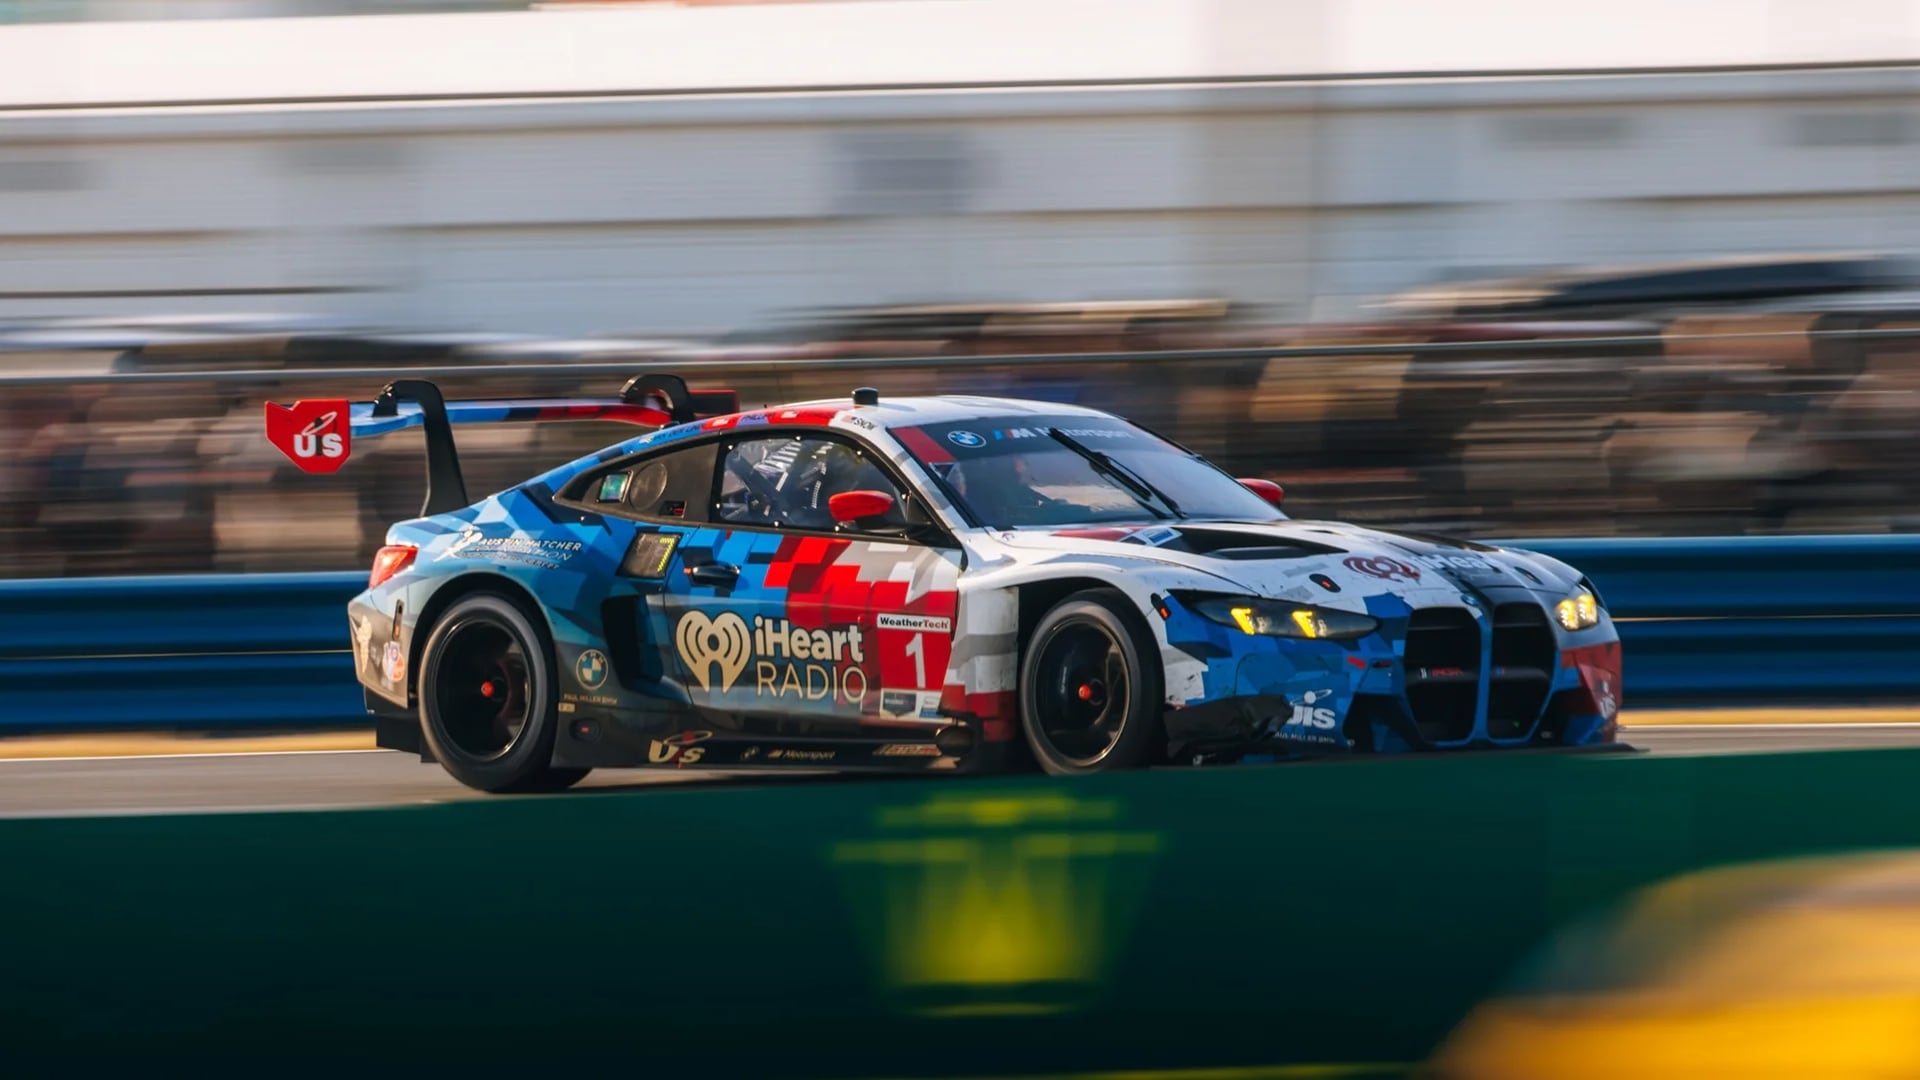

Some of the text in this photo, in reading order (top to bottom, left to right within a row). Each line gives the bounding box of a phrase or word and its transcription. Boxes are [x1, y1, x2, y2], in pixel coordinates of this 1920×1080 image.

[524, 538, 583, 551] HATCHER
[754, 615, 864, 663] iHeart
[879, 616, 949, 630] WeatherTech
[905, 632, 926, 689] 1
[756, 661, 867, 704] RADIO
